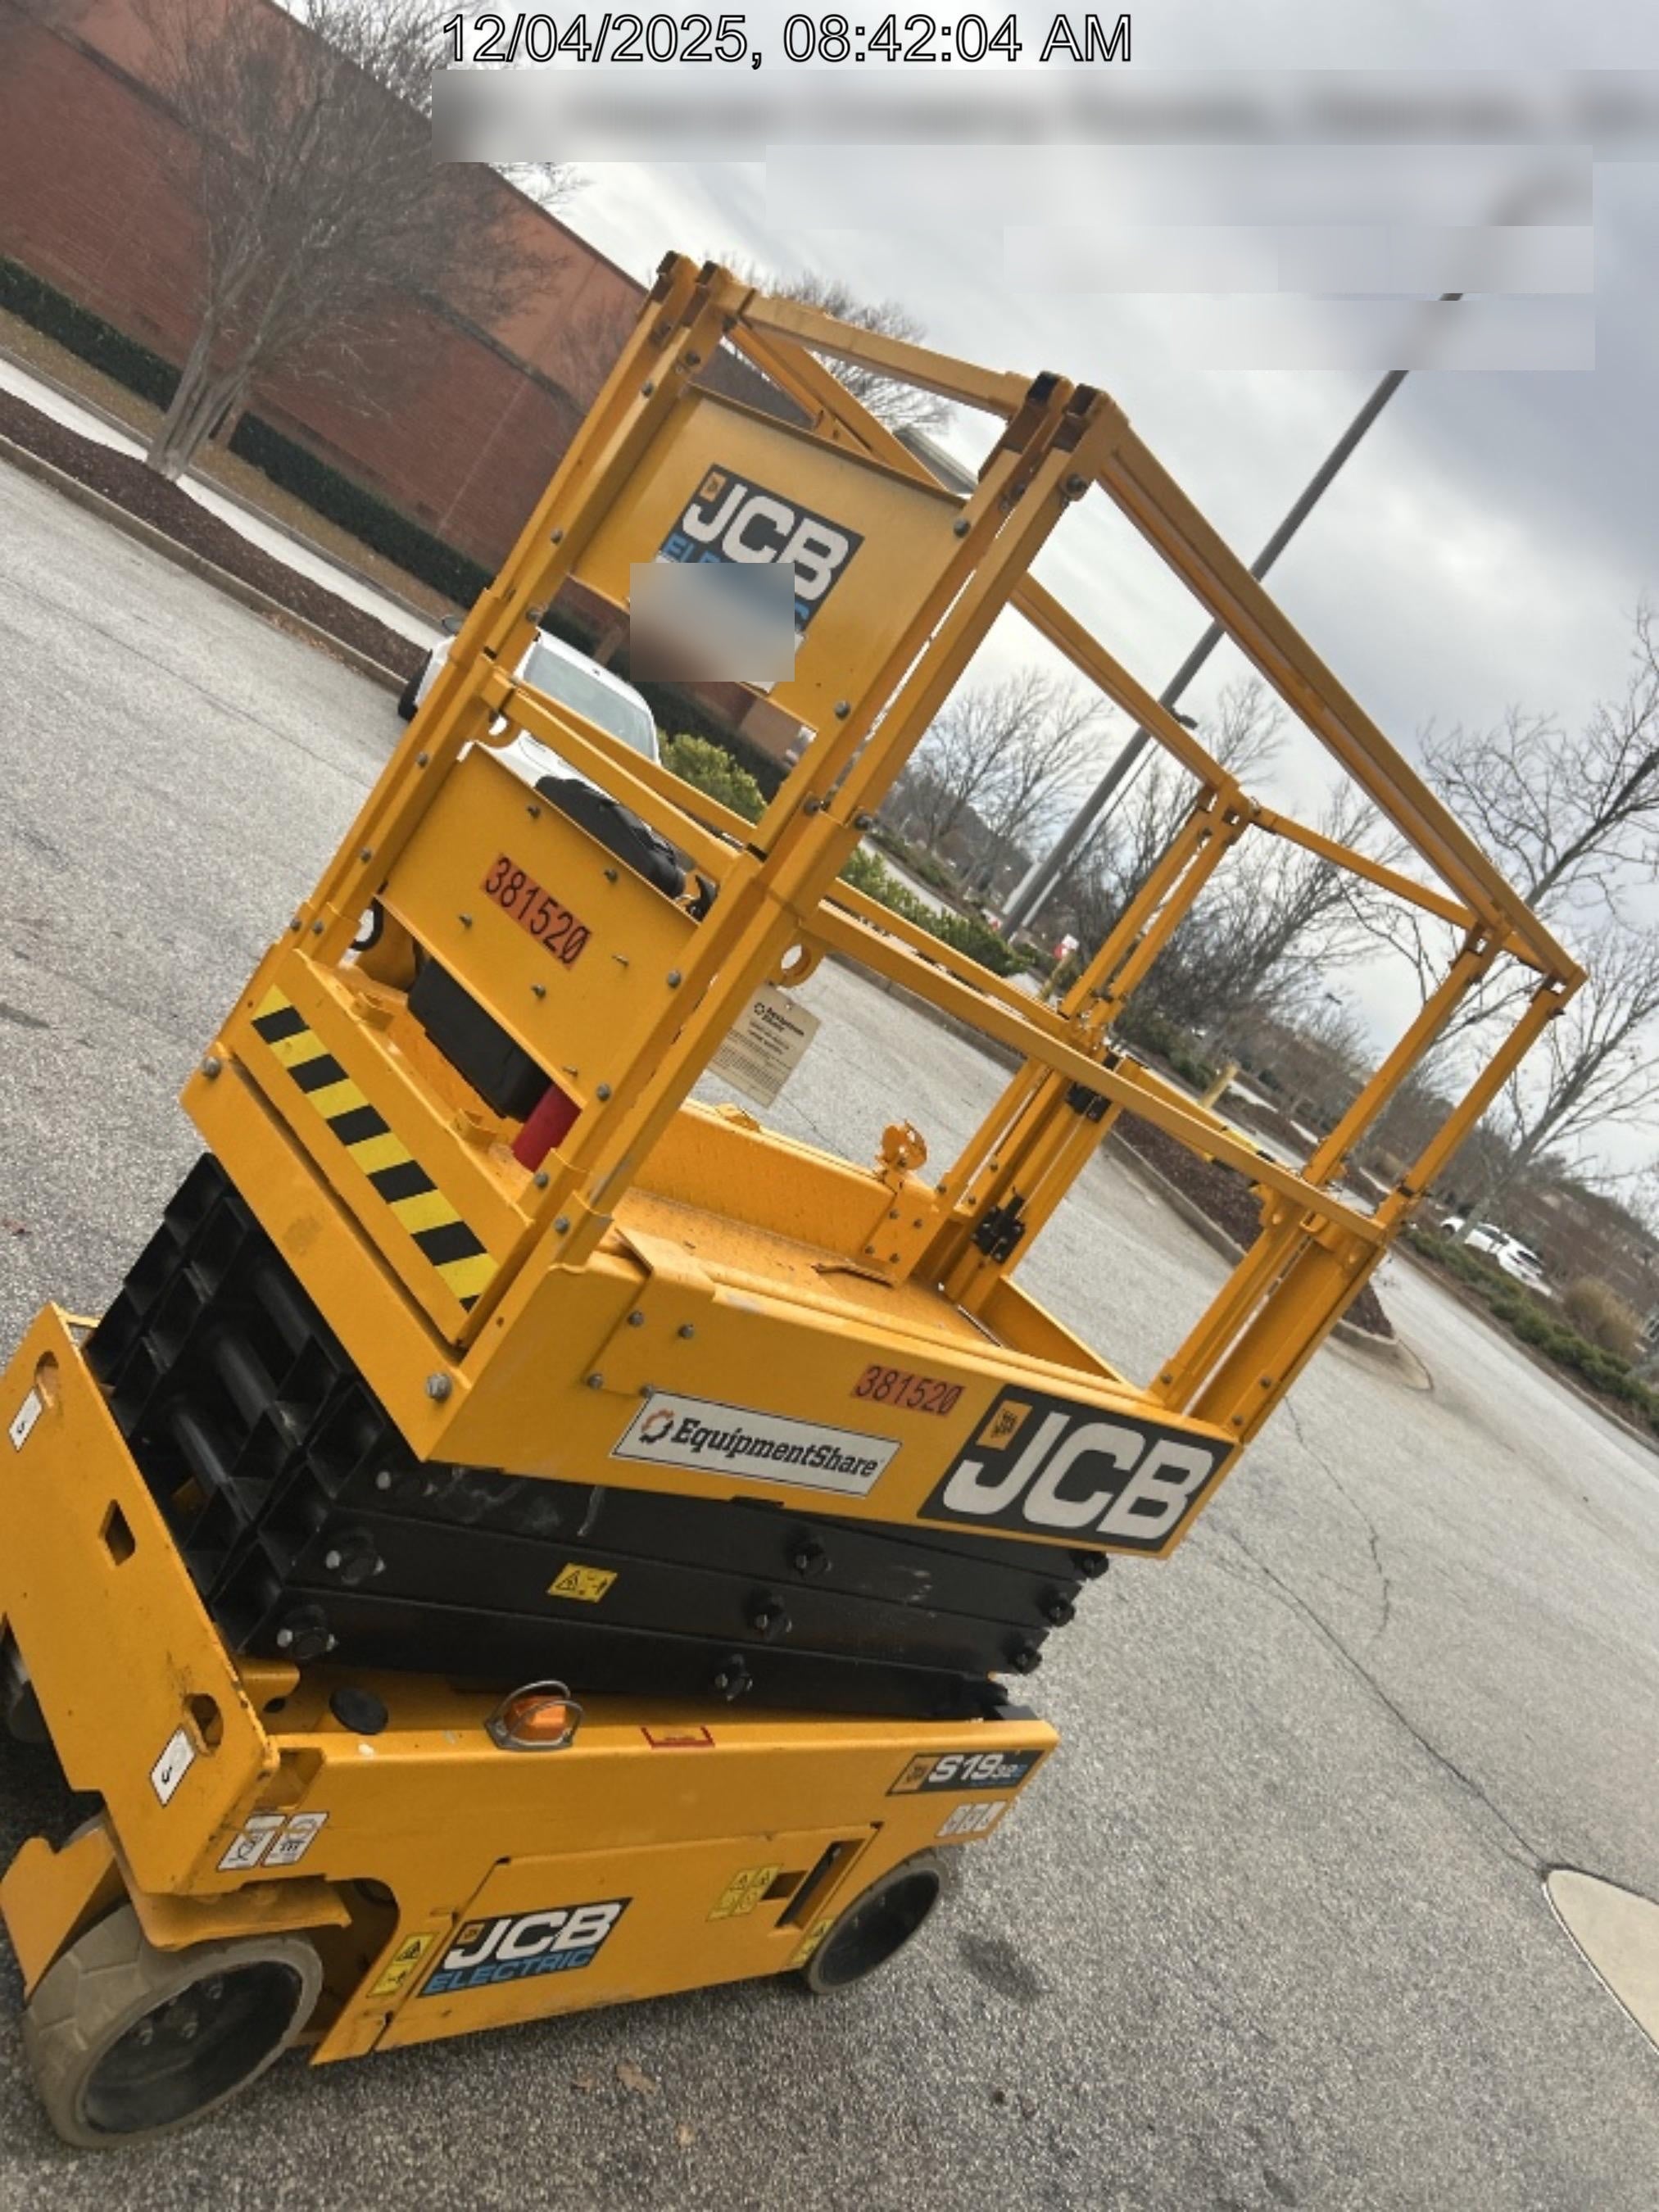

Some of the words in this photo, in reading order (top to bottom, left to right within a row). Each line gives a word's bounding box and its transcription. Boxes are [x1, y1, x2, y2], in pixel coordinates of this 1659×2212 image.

[682, 483, 849, 601] JCB
[486, 857, 592, 964] 381520
[855, 1366, 963, 1413] 381520
[671, 1417, 879, 1477] EquipmentShare
[942, 1411, 1213, 1539] JCB
[444, 1902, 623, 1969] JCB
[423, 1947, 596, 1994] ELECTRIC
